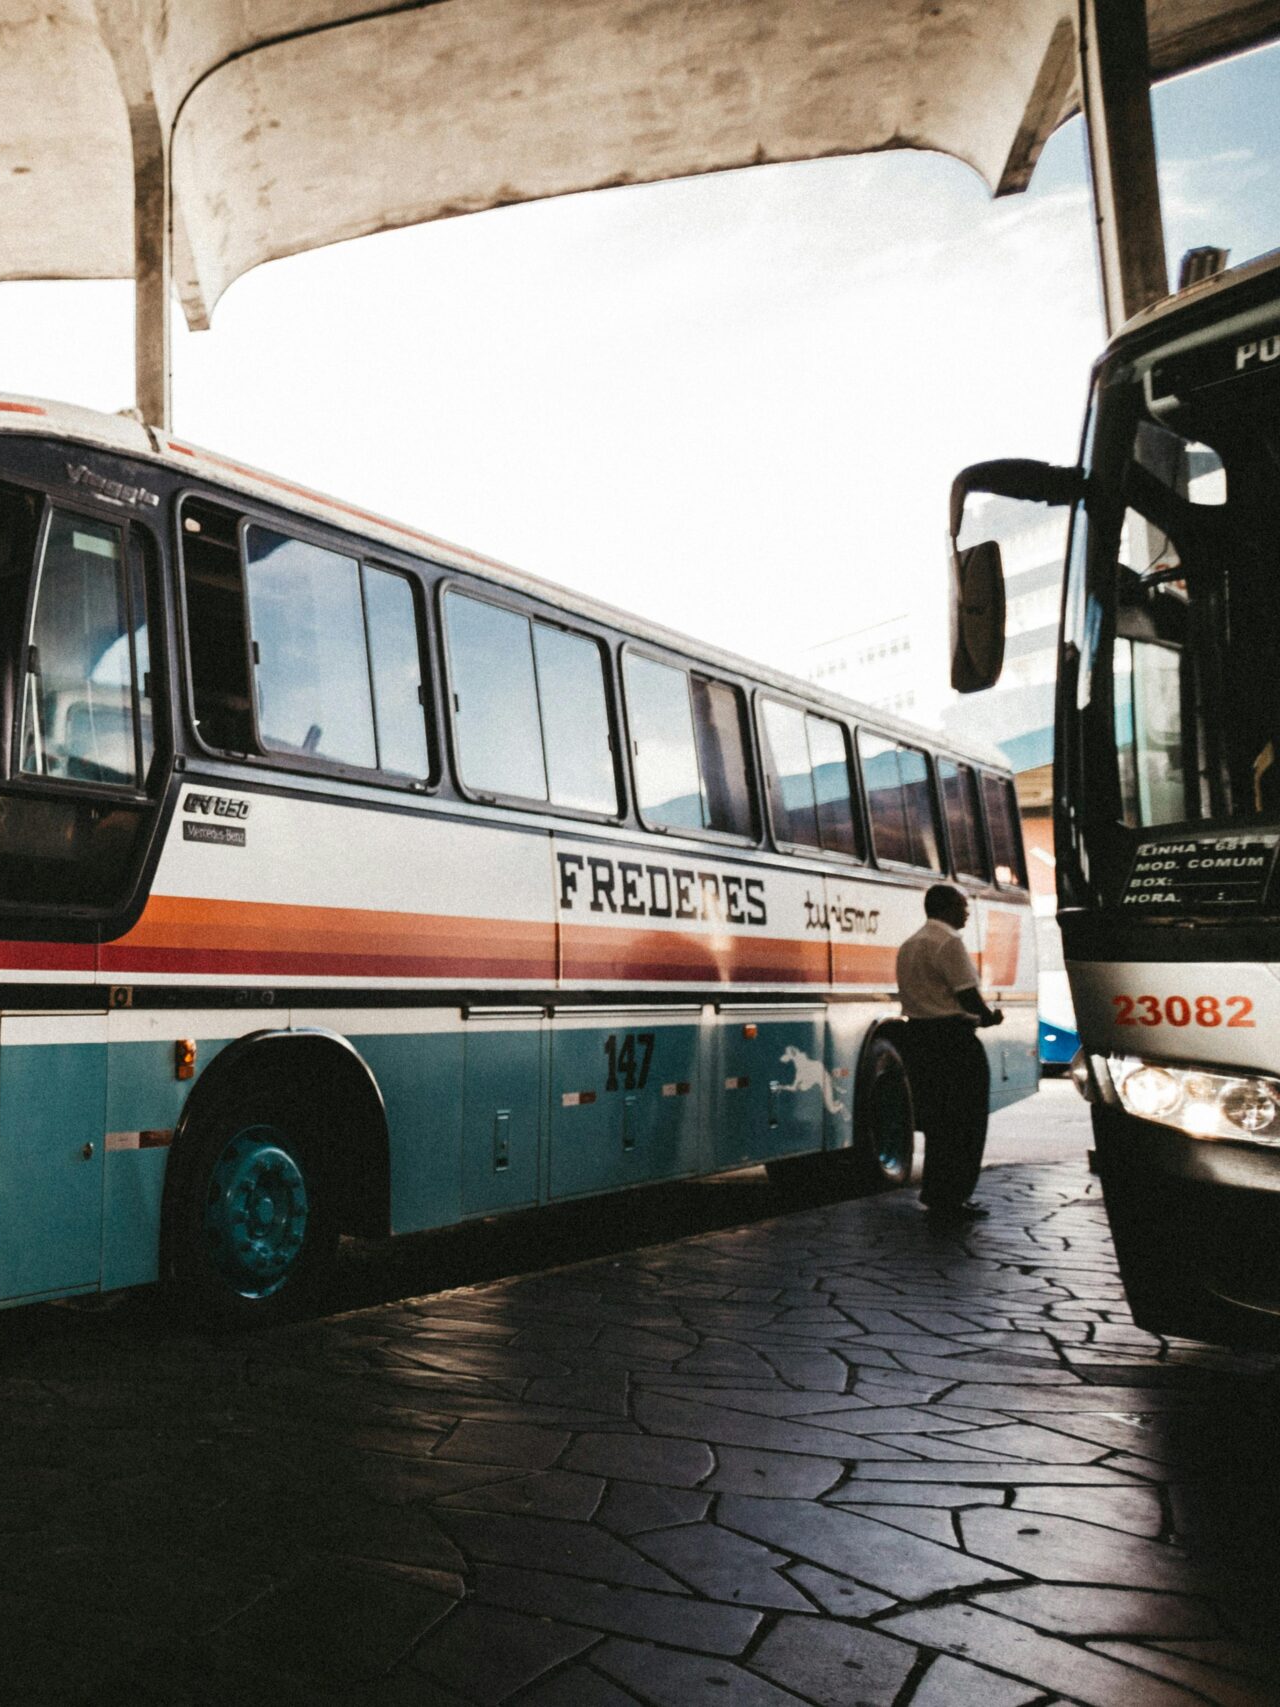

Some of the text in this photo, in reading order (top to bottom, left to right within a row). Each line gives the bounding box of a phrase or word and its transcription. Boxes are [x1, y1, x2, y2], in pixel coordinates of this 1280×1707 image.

[1136, 857, 1264, 872] MOD. COMUM
[1140, 843, 1197, 856] LINHA
[804, 891, 880, 934] turismo
[1113, 995, 1256, 1028] 23082
[605, 1033, 655, 1091] 147
